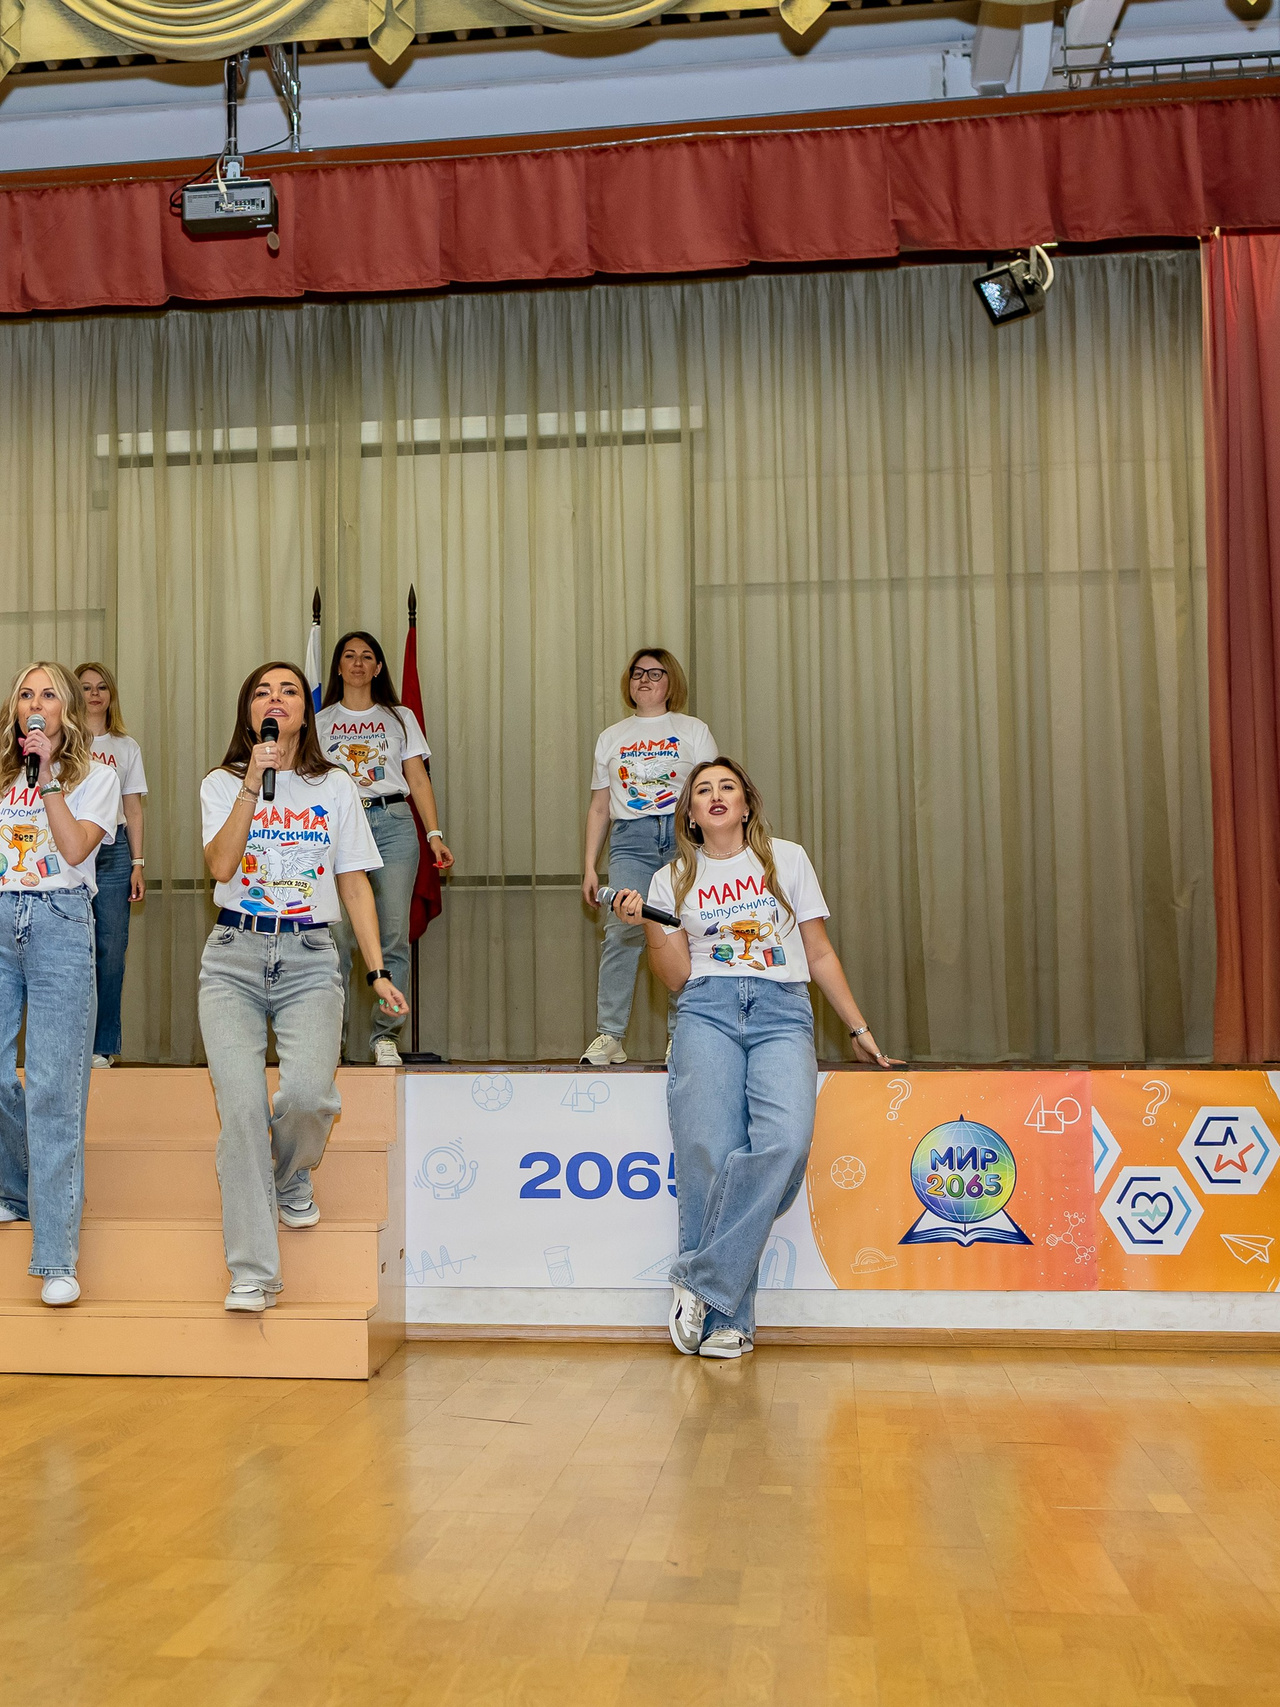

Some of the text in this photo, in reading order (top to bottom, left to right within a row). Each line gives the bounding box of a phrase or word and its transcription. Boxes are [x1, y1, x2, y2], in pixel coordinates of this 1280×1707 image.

[331, 721, 386, 735] МАМА
[619, 739, 679, 754] МАМА
[13, 833, 34, 843] 2025
[699, 896, 777, 920] выпускника
[930, 1146, 999, 1171] МИР
[926, 1173, 1003, 1198] 2065
